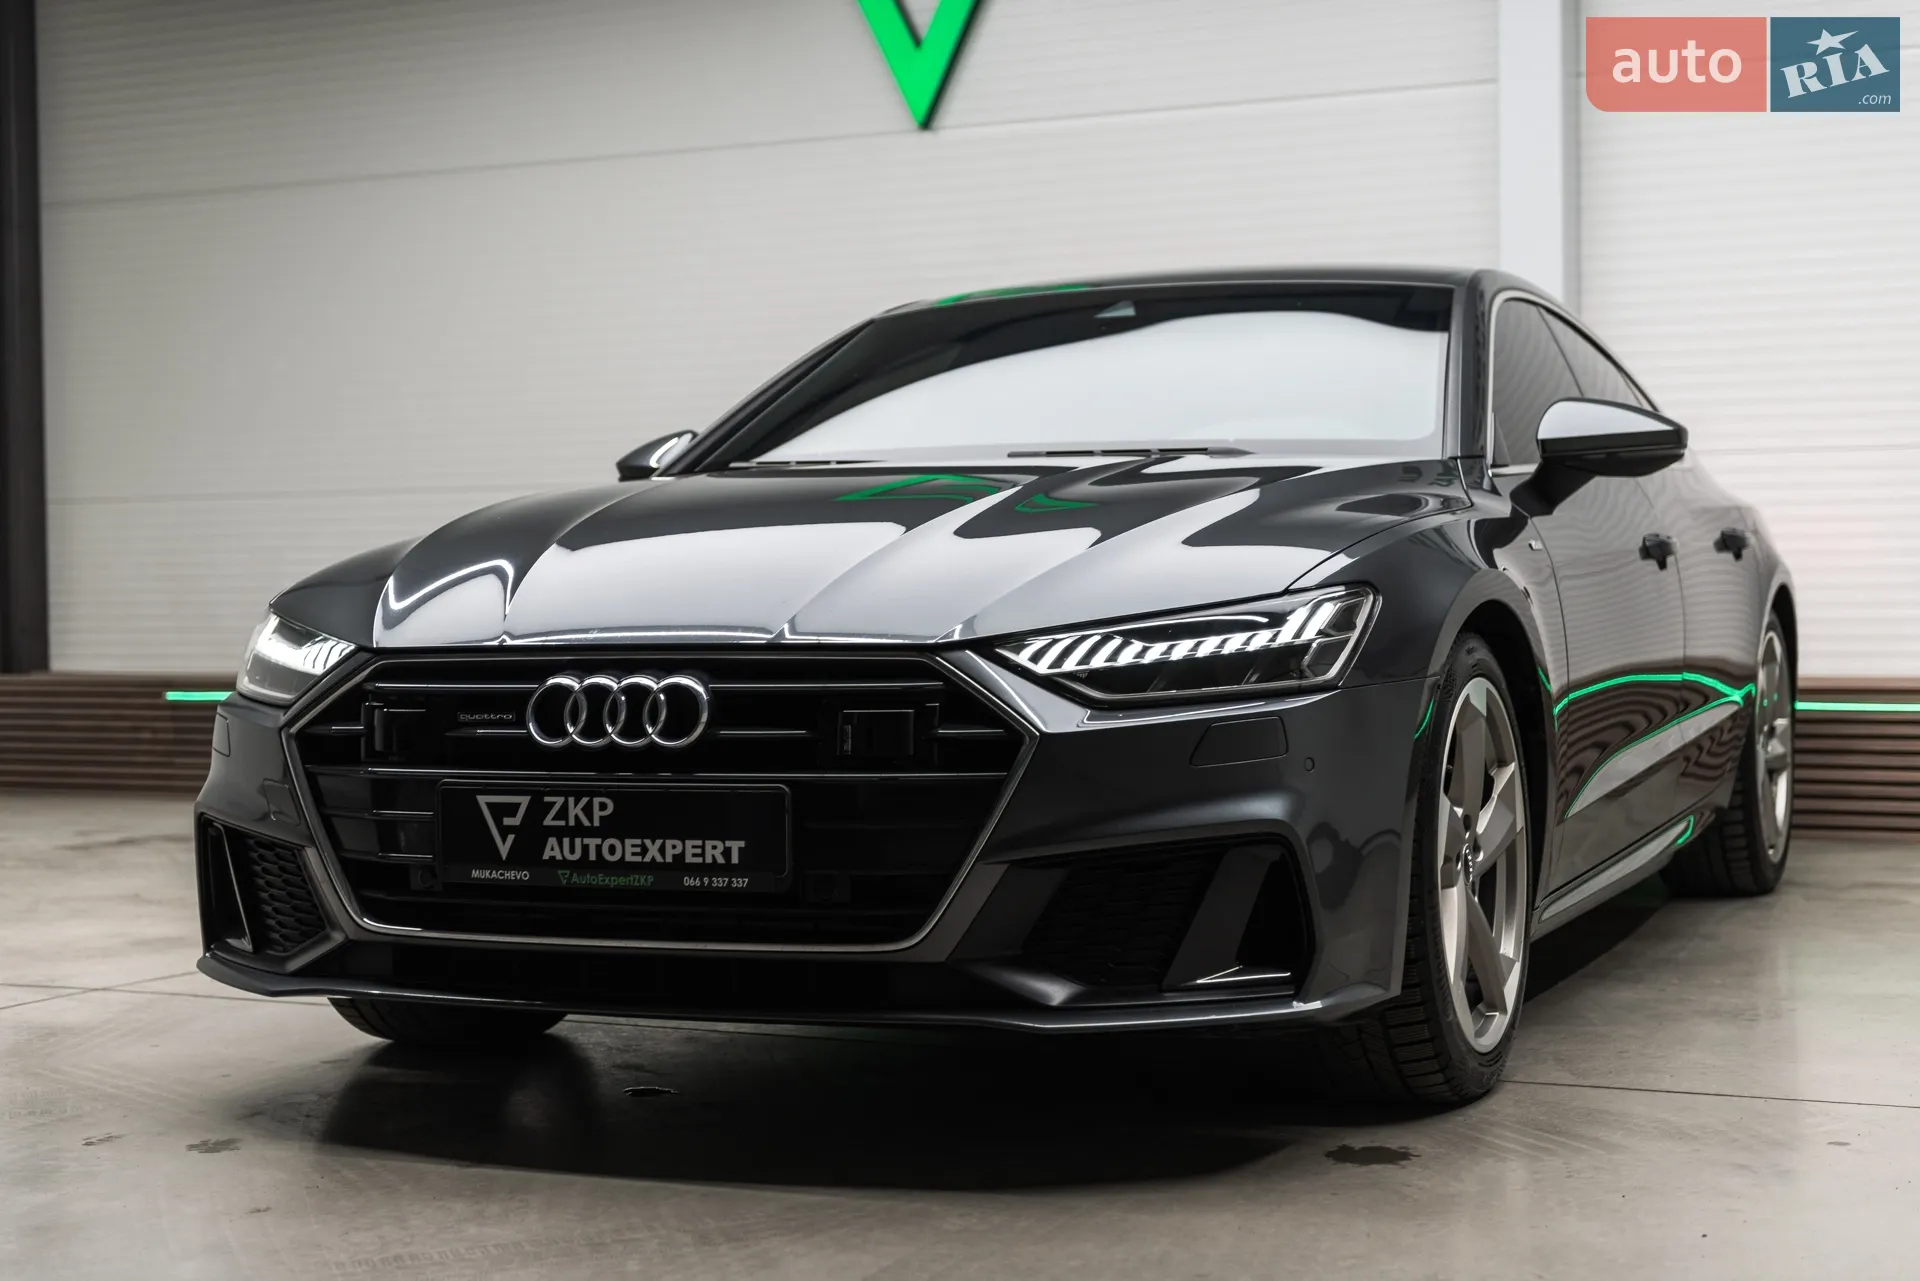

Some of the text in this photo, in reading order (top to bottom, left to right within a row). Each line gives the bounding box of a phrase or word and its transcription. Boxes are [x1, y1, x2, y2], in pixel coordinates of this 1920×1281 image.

[459, 712, 514, 721] quattro
[542, 796, 614, 827] ZKP
[542, 837, 745, 865] AUTOEXPERT
[471, 869, 530, 881] MUKACHEVO
[571, 872, 654, 888] AutoExpertZKP
[683, 876, 749, 888] 066 9 337 337
